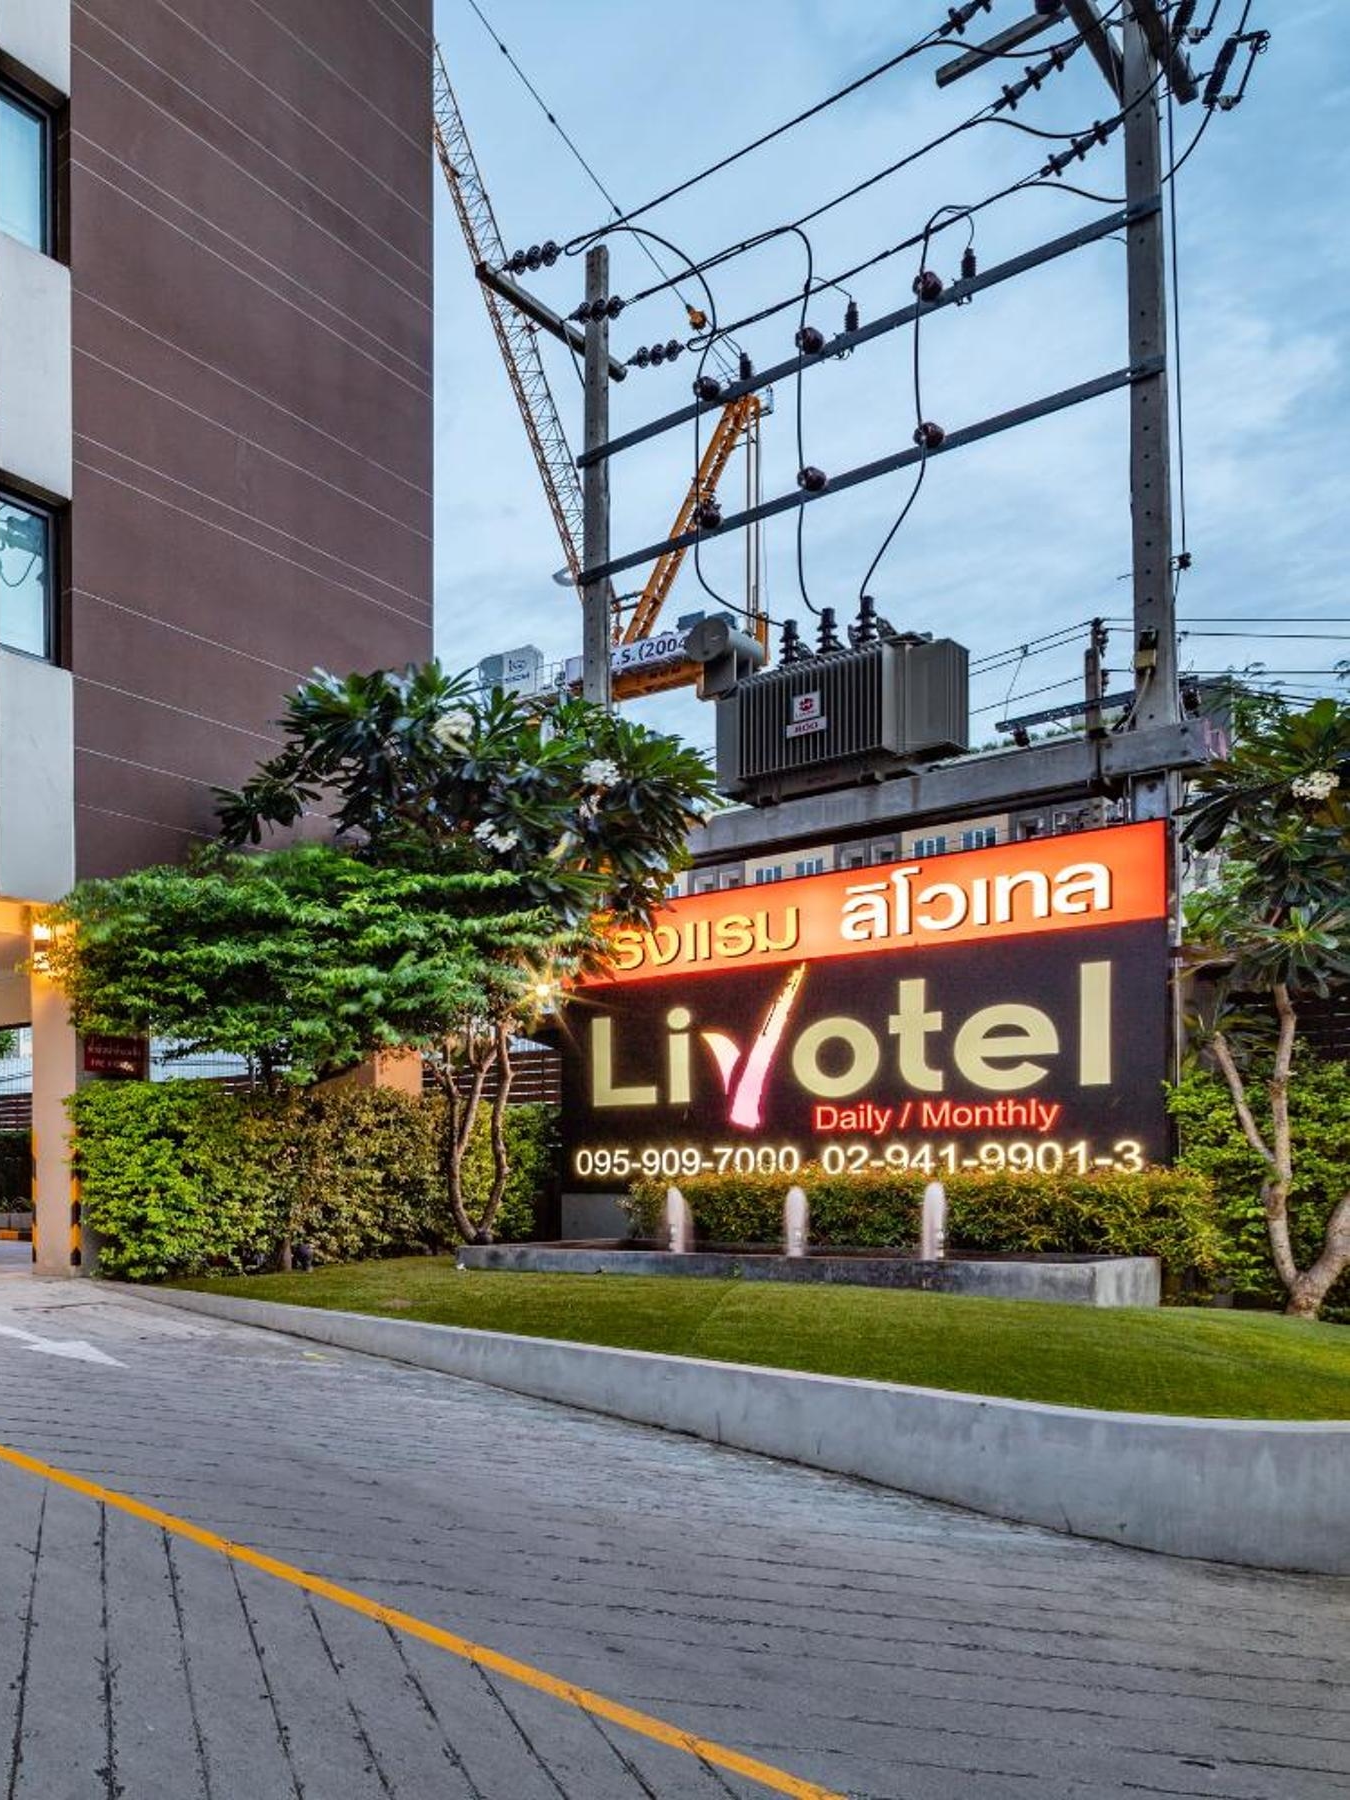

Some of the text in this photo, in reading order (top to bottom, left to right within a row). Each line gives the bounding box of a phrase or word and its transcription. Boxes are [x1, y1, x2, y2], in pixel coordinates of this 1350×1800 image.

[611, 906, 801, 971] รงแรม
[814, 1103, 893, 1135] Daily
[921, 1098, 1061, 1132] Monthly
[822, 1140, 1144, 1175] 02-941-9901-3
